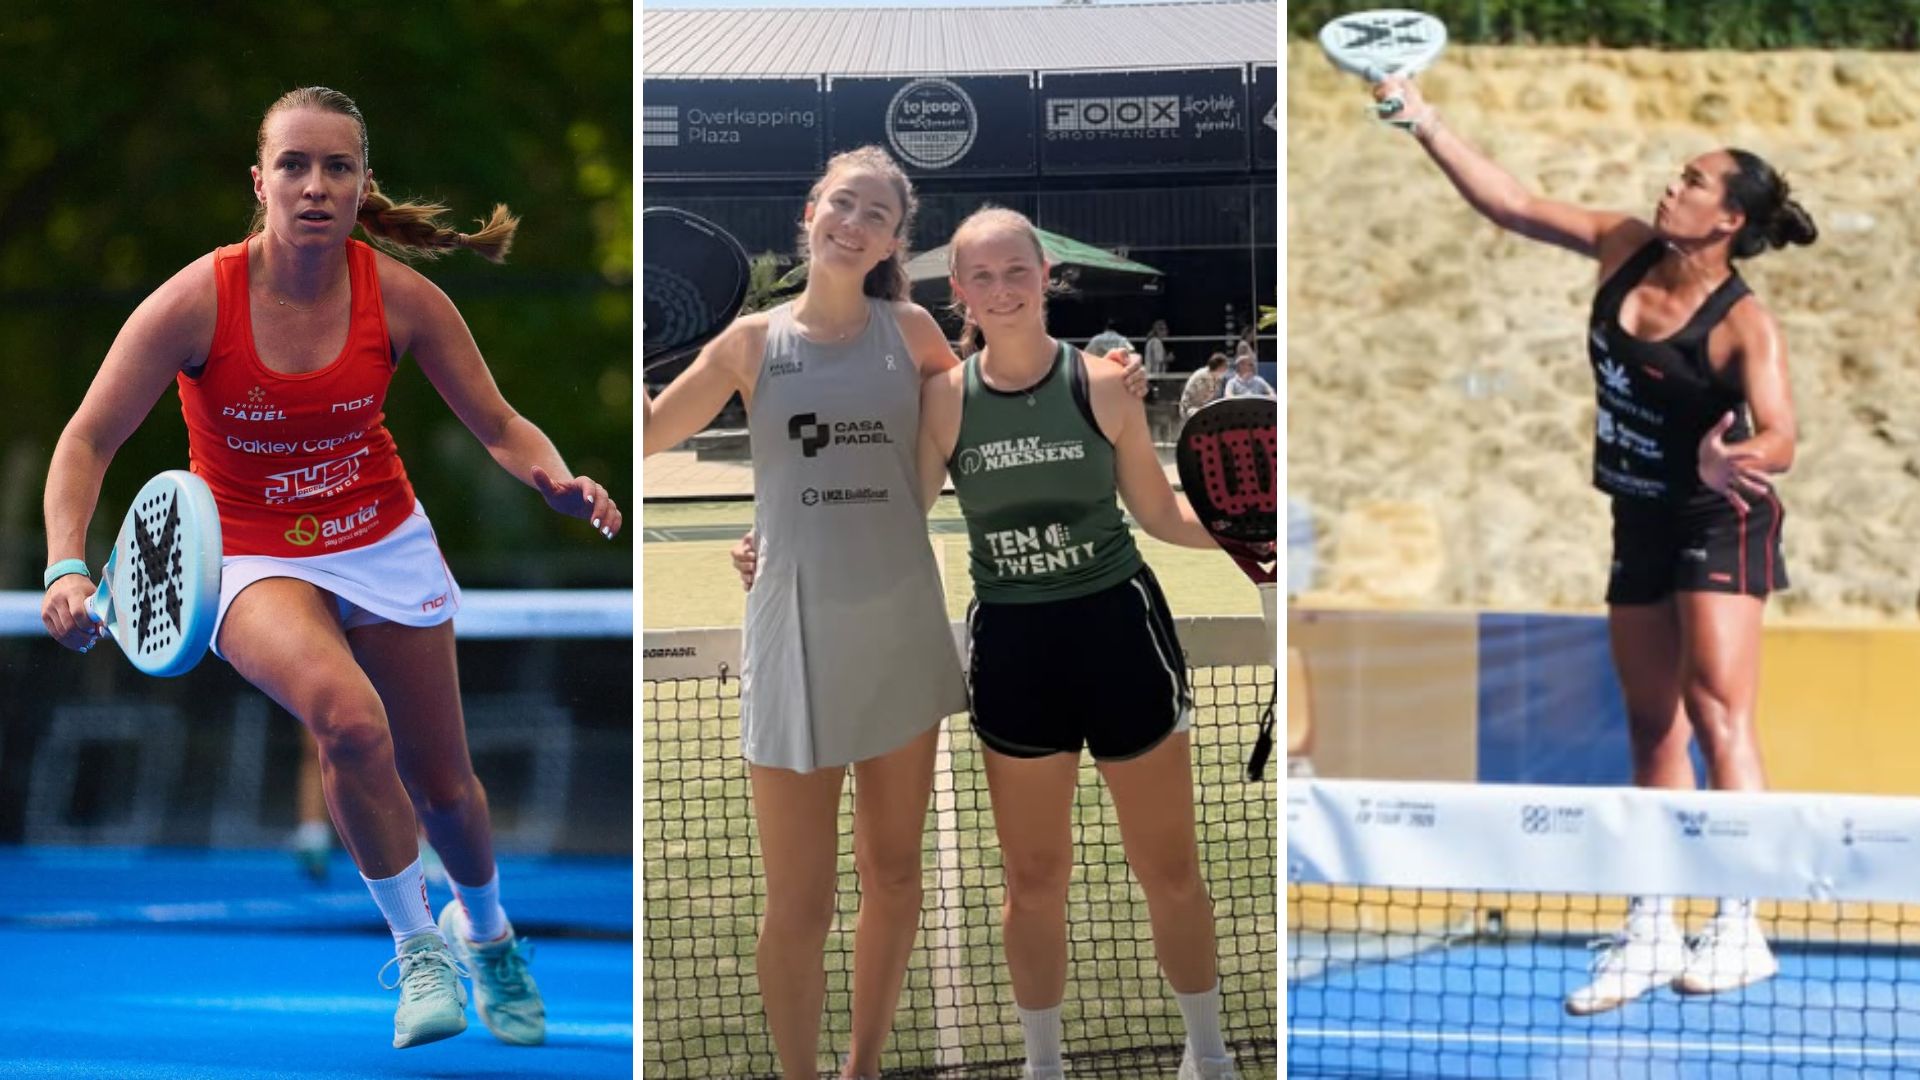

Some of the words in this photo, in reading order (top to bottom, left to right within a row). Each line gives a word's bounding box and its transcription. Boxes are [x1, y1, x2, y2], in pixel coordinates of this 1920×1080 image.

[687, 107, 814, 127] Overkapping
[1048, 97, 1179, 129] FOOX
[689, 128, 740, 143] Plaza
[1047, 129, 1180, 141] GROOTHANDEL
[222, 406, 287, 421] PADEL
[236, 402, 275, 410] PREMIER
[835, 421, 885, 433] CASA
[227, 435, 298, 454] Oakley
[835, 433, 894, 444] PADEL
[979, 436, 1040, 457] WILLY
[985, 445, 1085, 471] NAESSENS
[985, 526, 1040, 557] TEN
[994, 541, 1095, 577] TWENTY
